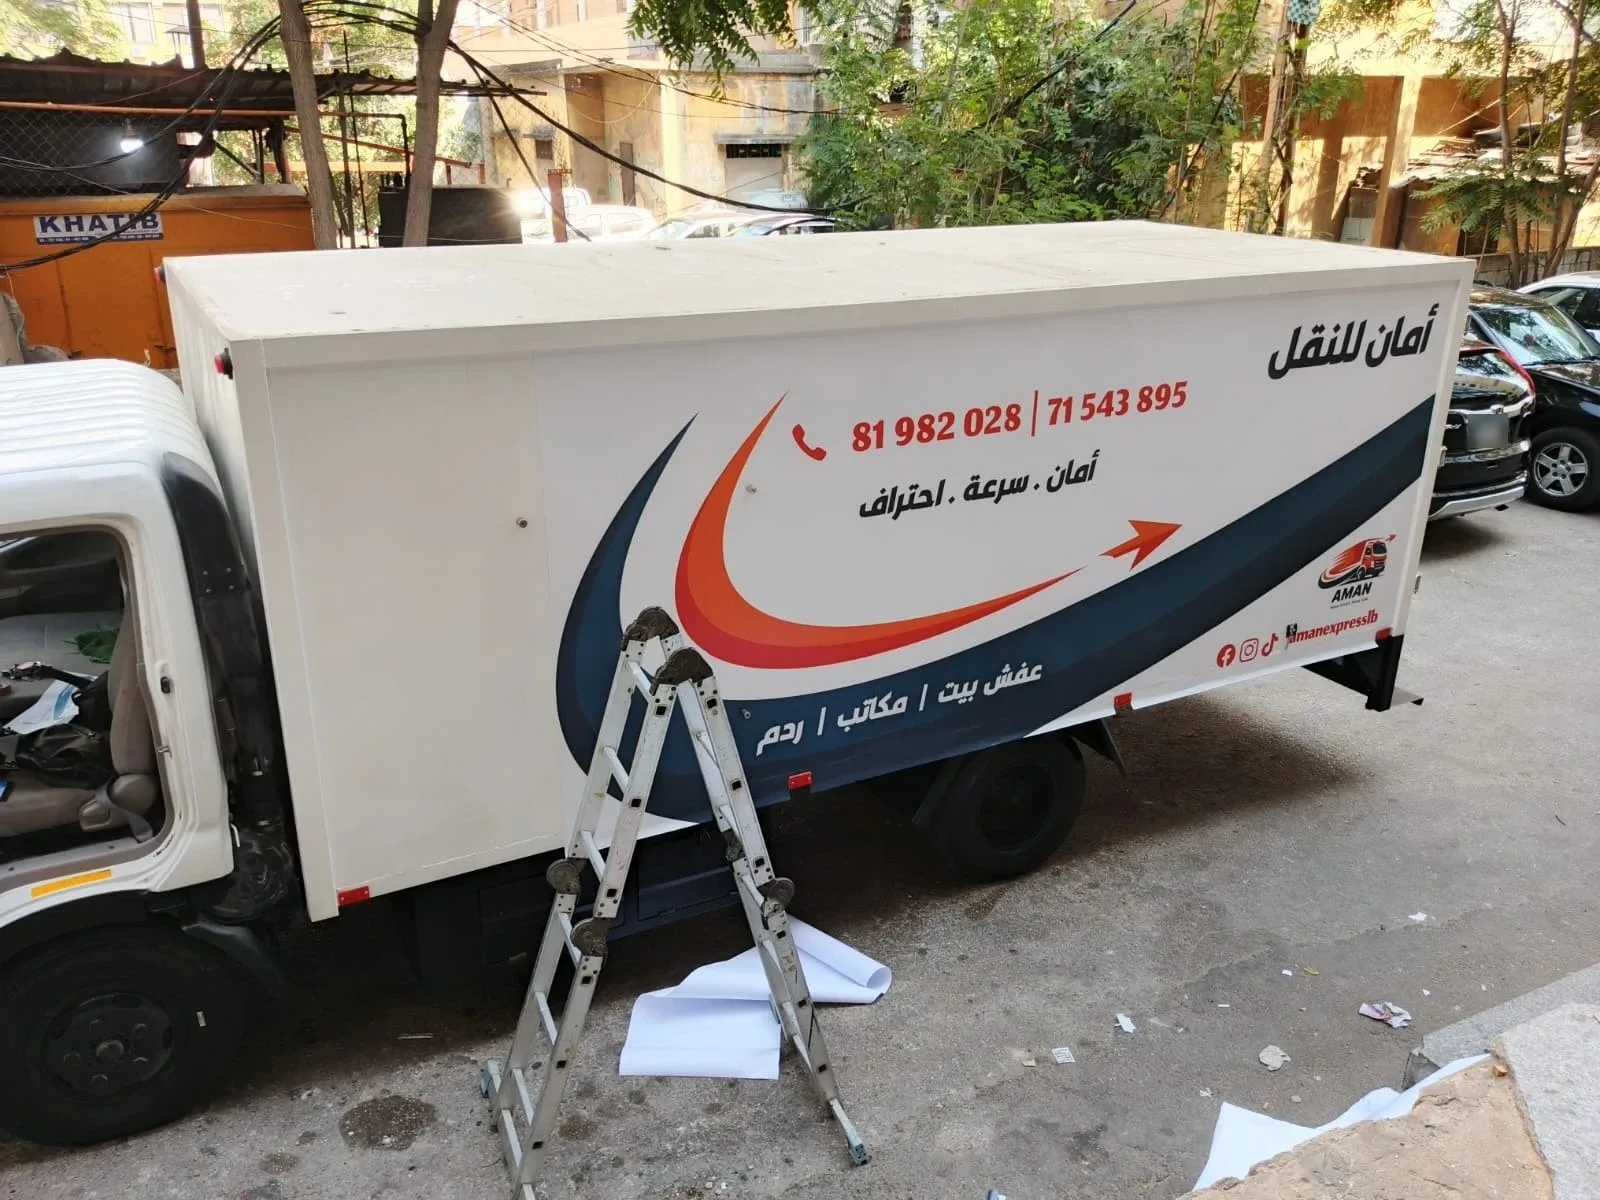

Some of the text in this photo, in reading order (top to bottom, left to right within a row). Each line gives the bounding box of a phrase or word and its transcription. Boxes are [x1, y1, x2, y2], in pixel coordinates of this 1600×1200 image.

[39, 212, 159, 233] KHATIB
[1267, 302, 1440, 380] أمان للنقل
[851, 419, 885, 453] 81
[893, 411, 956, 447] 982
[962, 402, 1022, 438] 028
[1047, 396, 1074, 426] 71
[1080, 388, 1130, 422] 543
[1135, 380, 1188, 414] 895
[1047, 449, 1099, 493] أمان
[859, 478, 946, 521] احتراف
[963, 474, 1030, 505] سرعة
[1331, 581, 1373, 603] AMAN
[1288, 609, 1379, 643] amanexpresslb
[937, 679, 978, 705] بيت
[983, 661, 1043, 696] عفش
[836, 690, 909, 733] مكاتب
[755, 719, 805, 757] ردم
